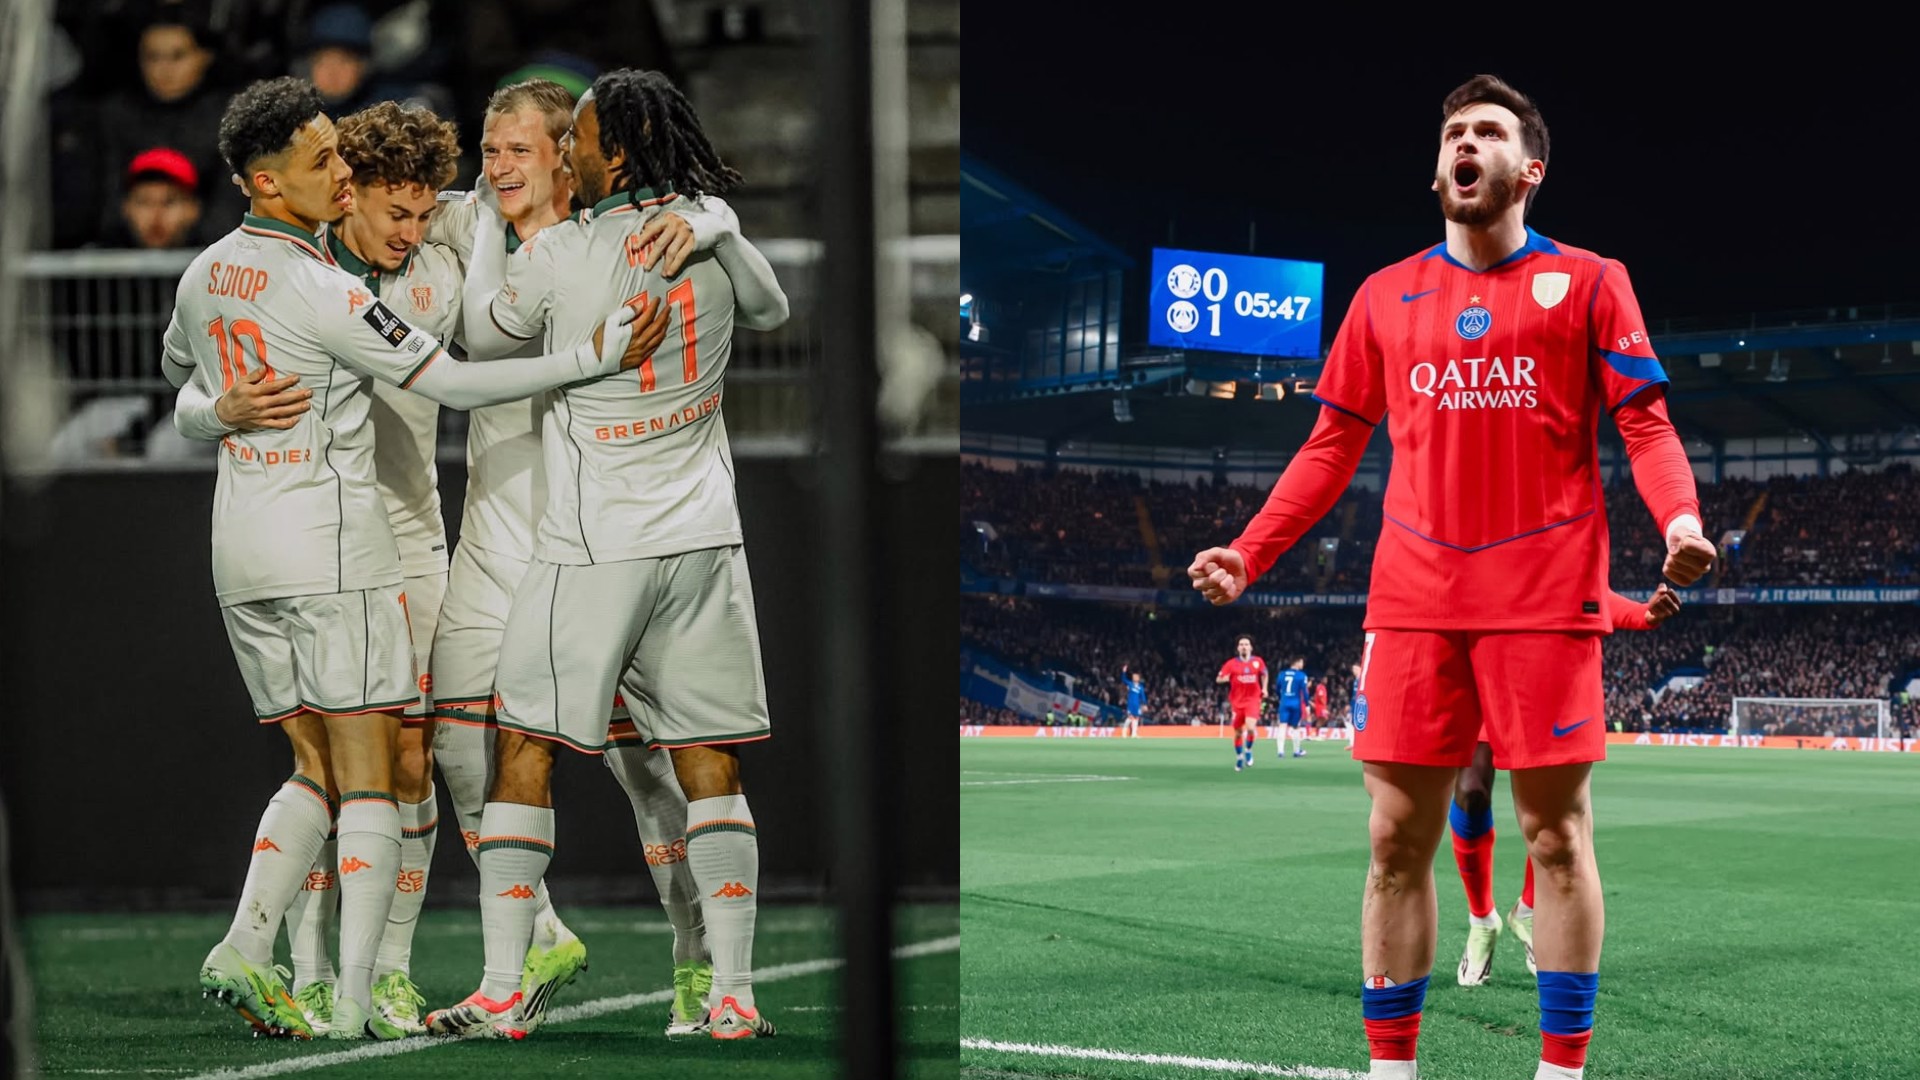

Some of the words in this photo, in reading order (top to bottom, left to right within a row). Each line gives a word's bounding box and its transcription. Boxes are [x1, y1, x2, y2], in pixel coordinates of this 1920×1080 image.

[208, 261, 268, 301] S.DIOP
[1202, 267, 1228, 302] 0
[1234, 290, 1311, 321] 05:47
[1206, 303, 1221, 337] 1
[208, 316, 276, 396] 10
[1410, 356, 1538, 398] QATAR
[1437, 389, 1538, 410] AIRWAYS
[595, 393, 720, 441] GRENADIER
[1284, 675, 1294, 694] 7
[1052, 727, 1086, 738] JUST
[1088, 727, 1116, 738] EAT
[1660, 734, 1717, 747] JUST
[1719, 735, 1764, 748] EAT
[1858, 737, 1917, 752] JUST
[302, 880, 334, 891] ICE
[308, 870, 335, 882] GC
